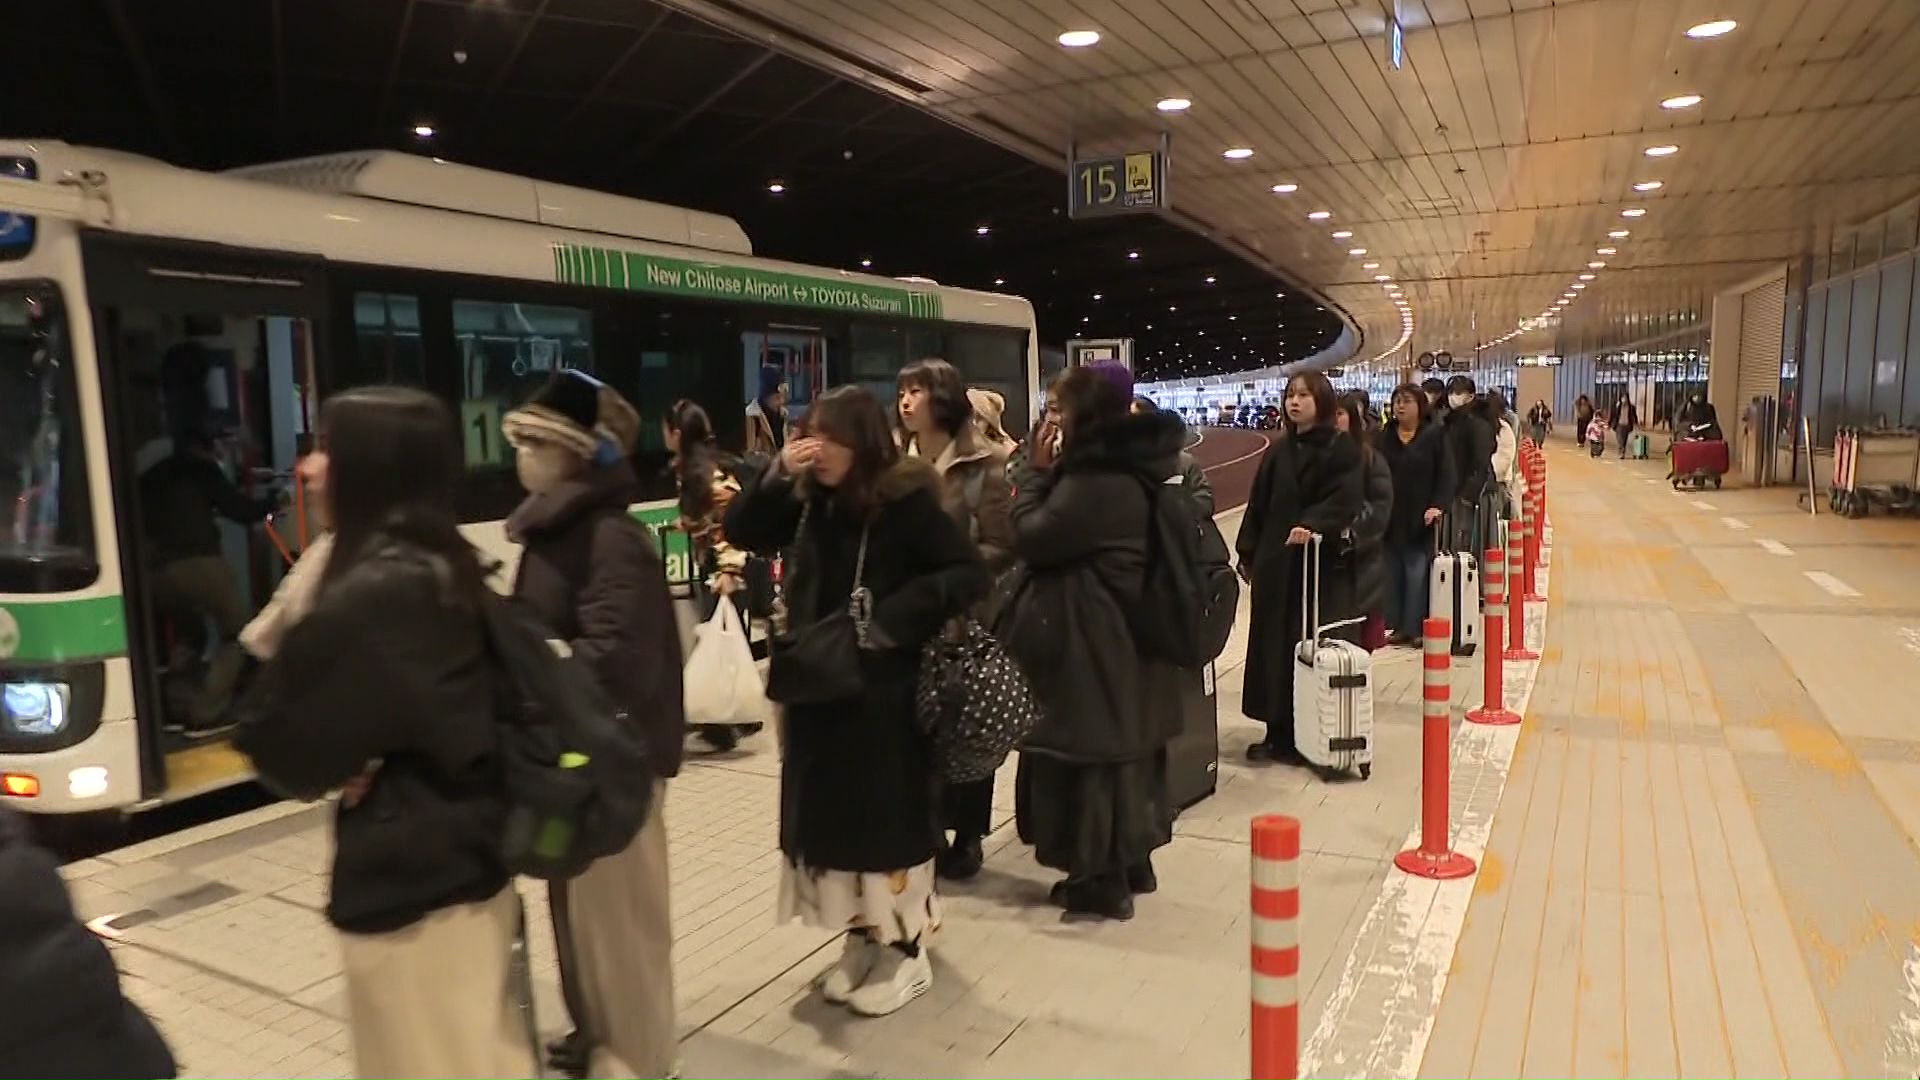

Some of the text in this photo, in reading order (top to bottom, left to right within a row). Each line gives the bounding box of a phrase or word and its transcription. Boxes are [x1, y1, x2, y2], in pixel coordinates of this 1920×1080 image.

[1081, 164, 1117, 206] 15
[646, 262, 901, 313] New Chitose Airport TOYOTA Suzuran
[472, 411, 489, 462] 1
